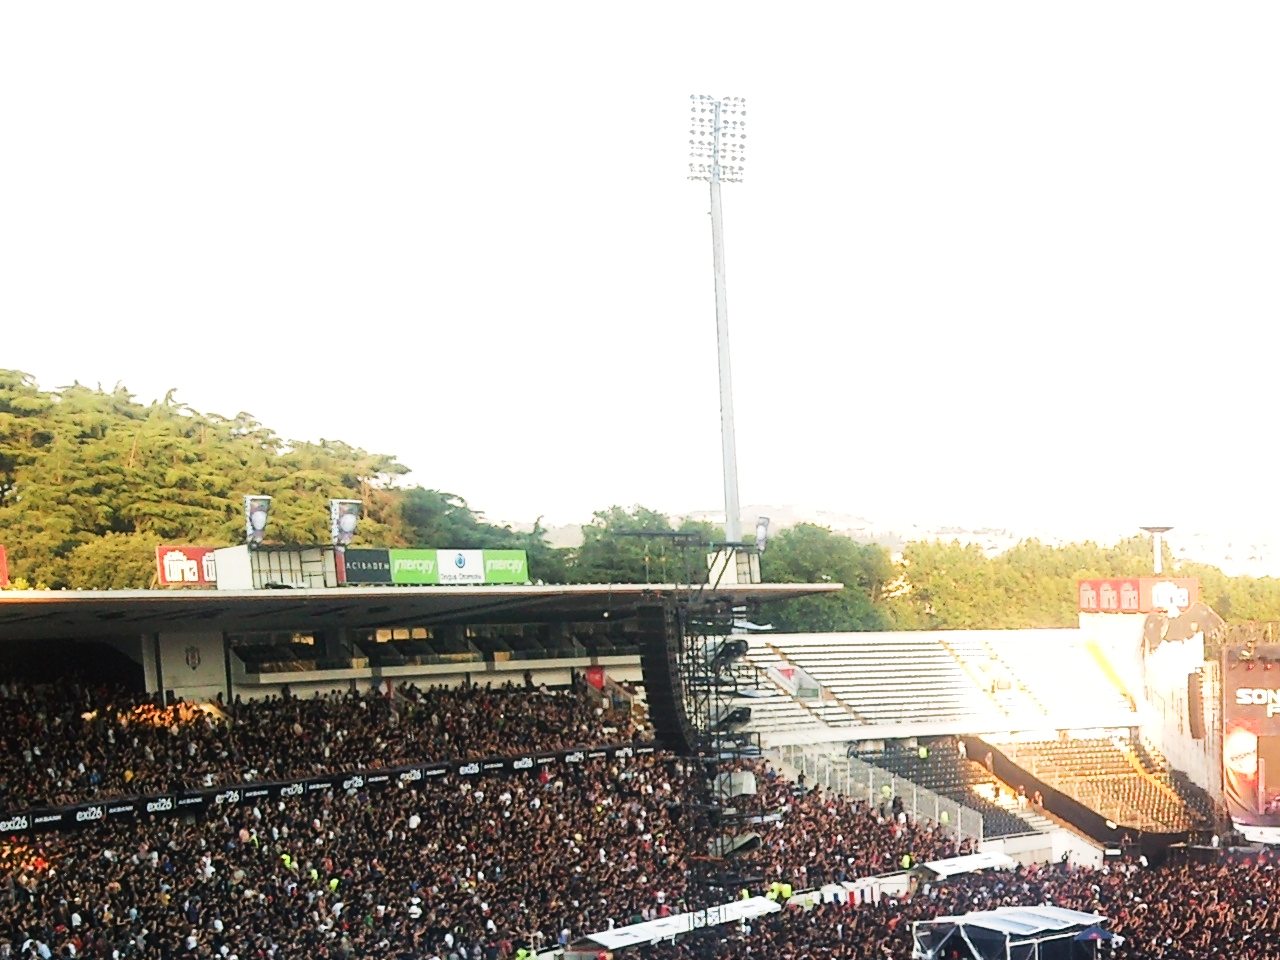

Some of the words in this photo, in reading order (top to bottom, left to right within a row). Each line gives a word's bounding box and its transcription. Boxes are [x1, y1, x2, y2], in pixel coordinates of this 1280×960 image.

[147, 797, 173, 812] exi26
[76, 806, 103, 822] exi26
[0, 815, 28, 832] exi26
